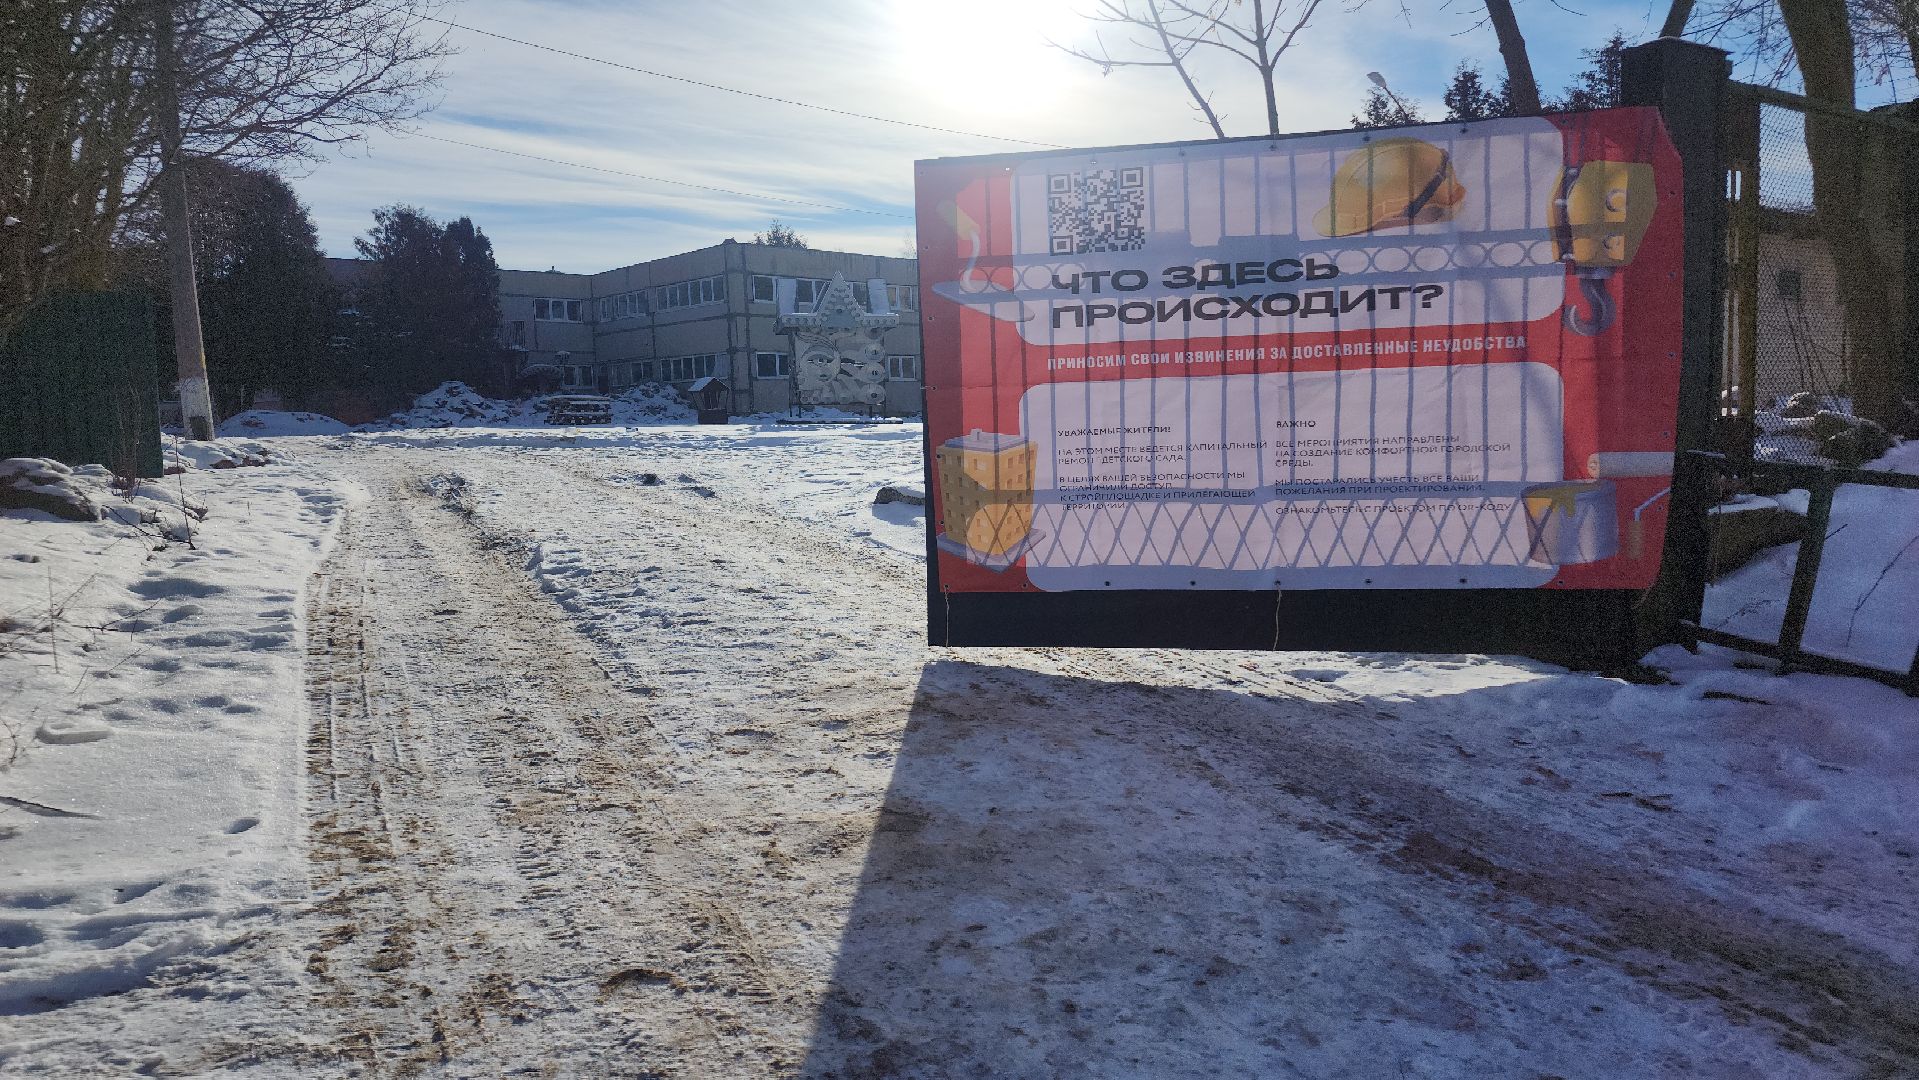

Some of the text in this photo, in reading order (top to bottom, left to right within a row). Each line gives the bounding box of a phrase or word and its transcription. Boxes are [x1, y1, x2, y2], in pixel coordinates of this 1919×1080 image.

[1052, 258, 1339, 294] ЧТО ЗДЕСЬ
[1053, 284, 1443, 328] ПРОИСХОДИТ?
[1048, 335, 1526, 370] ПРИНОСИМ СВОИ ИЗВИНЕНИЯ ЗА ДОСТАВЛЕННЫЕ НЕУДОБСТВА
[1276, 420, 1316, 428] ВАЖНО
[1057, 426, 1171, 437] УВАЖАЕМЫЕ ЖИТЕЛИ!
[1075, 447, 1103, 455] ЭТОМ
[1105, 446, 1137, 454] МЕСТЕ
[1139, 444, 1183, 453] ВЕДЕТСЯ
[1186, 440, 1267, 451] КАПИТАЛЬНЫЙ
[1276, 435, 1459, 448] ВСЕ МЕРОПРИЯТИЯ НАПРАВЛЕНЫ
[1292, 448, 1353, 457] СОЗДАНИЕ
[1355, 445, 1438, 455] КОМФОРТНОЙ
[1441, 442, 1511, 453] ГОРОДСКОЙ
[1102, 455, 1153, 464] ДЕТСКОГО
[1275, 459, 1313, 467] СРЕДЫ.
[1067, 476, 1100, 484] ЦЕЛЯХ
[1103, 473, 1138, 482] ВАШЕЙ
[1140, 472, 1225, 482] БЕЗОПАСНОСТИ
[1227, 471, 1245, 479] МЫ
[1275, 473, 1479, 487] МЫ ПОСТАРАЛИСЬ УЧЕСТЬ ВСЕ ВАШИ
[1060, 484, 1128, 492] ОГРАНИЧИЛИ
[1275, 486, 1347, 496] ПОЖЕЛАНИЯ
[1349, 486, 1372, 494] ПРИ
[1068, 492, 1161, 501] СТРОЙПЛОЩАДКЕ
[1173, 489, 1256, 499] ПРИЛЕГАЮЩЕЙ
[1275, 506, 1362, 515] ОЗНАКОМЬТЕСЬ
[1374, 504, 1436, 514] ПРОЕКТОМ
[1439, 503, 1456, 512] ПО
